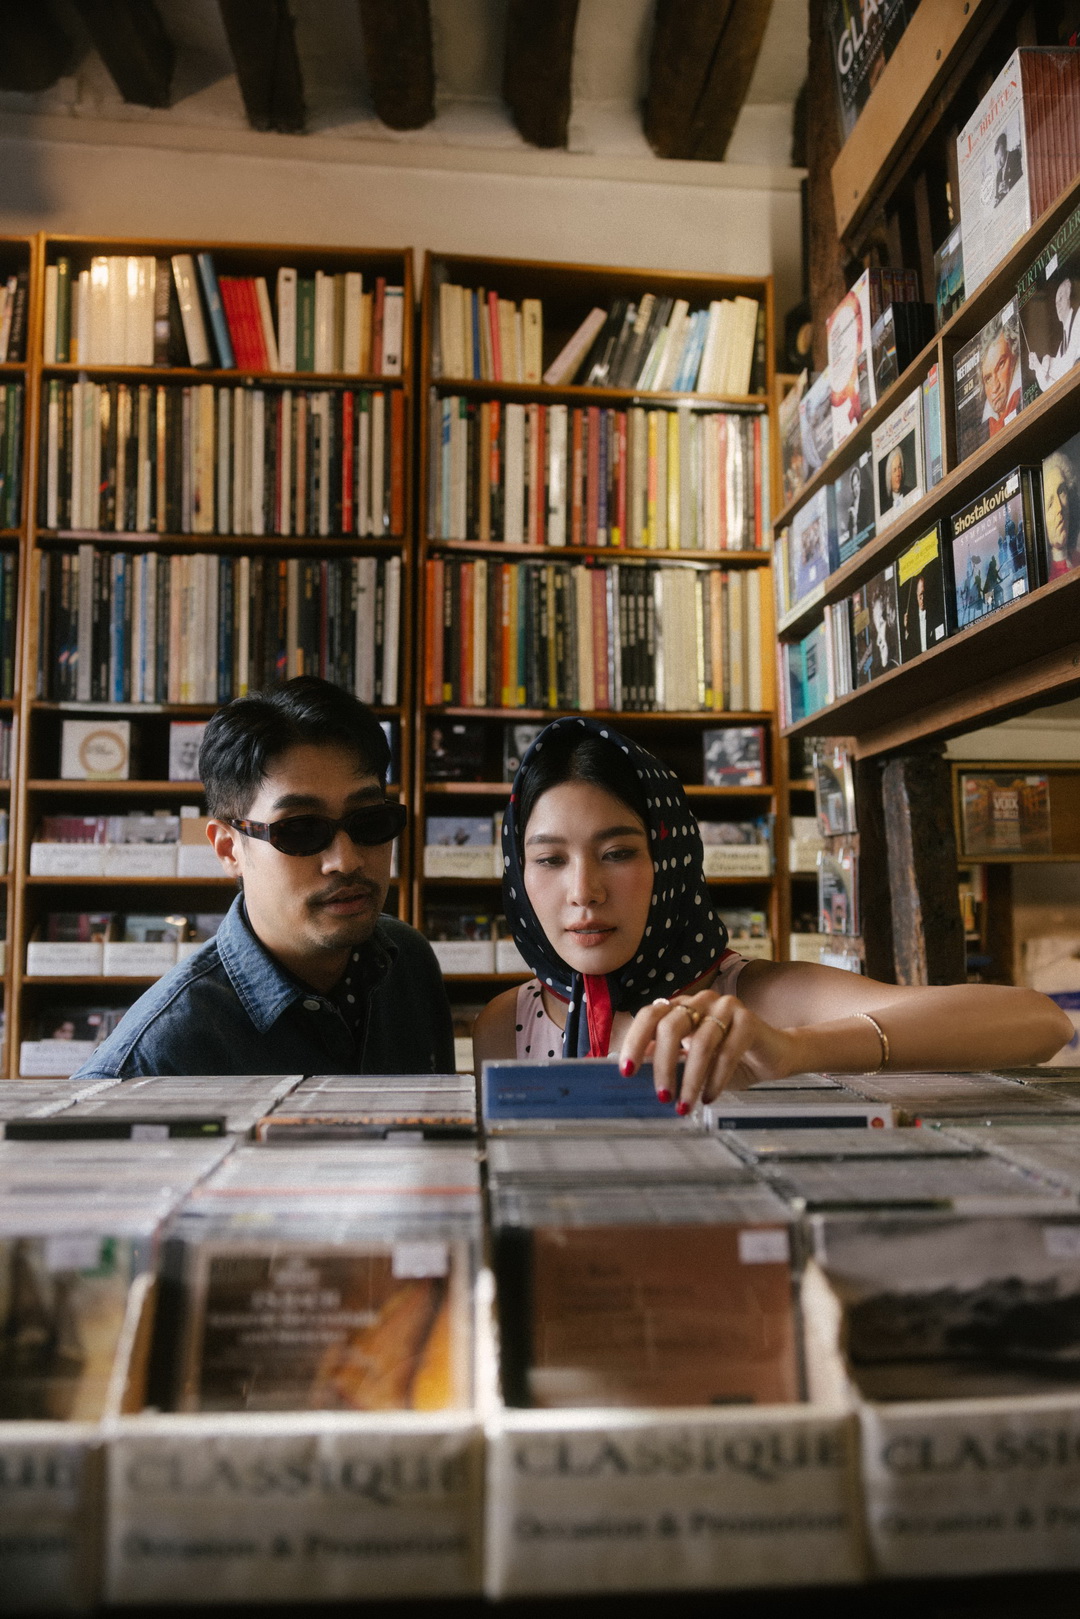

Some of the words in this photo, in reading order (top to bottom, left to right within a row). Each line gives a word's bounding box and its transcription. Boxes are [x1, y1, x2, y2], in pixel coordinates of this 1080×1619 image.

[960, 503, 1012, 546] SYMPHONIES
[514, 1434, 848, 1482] CLASSIQUE
[881, 1431, 1080, 1475] CLASSI
